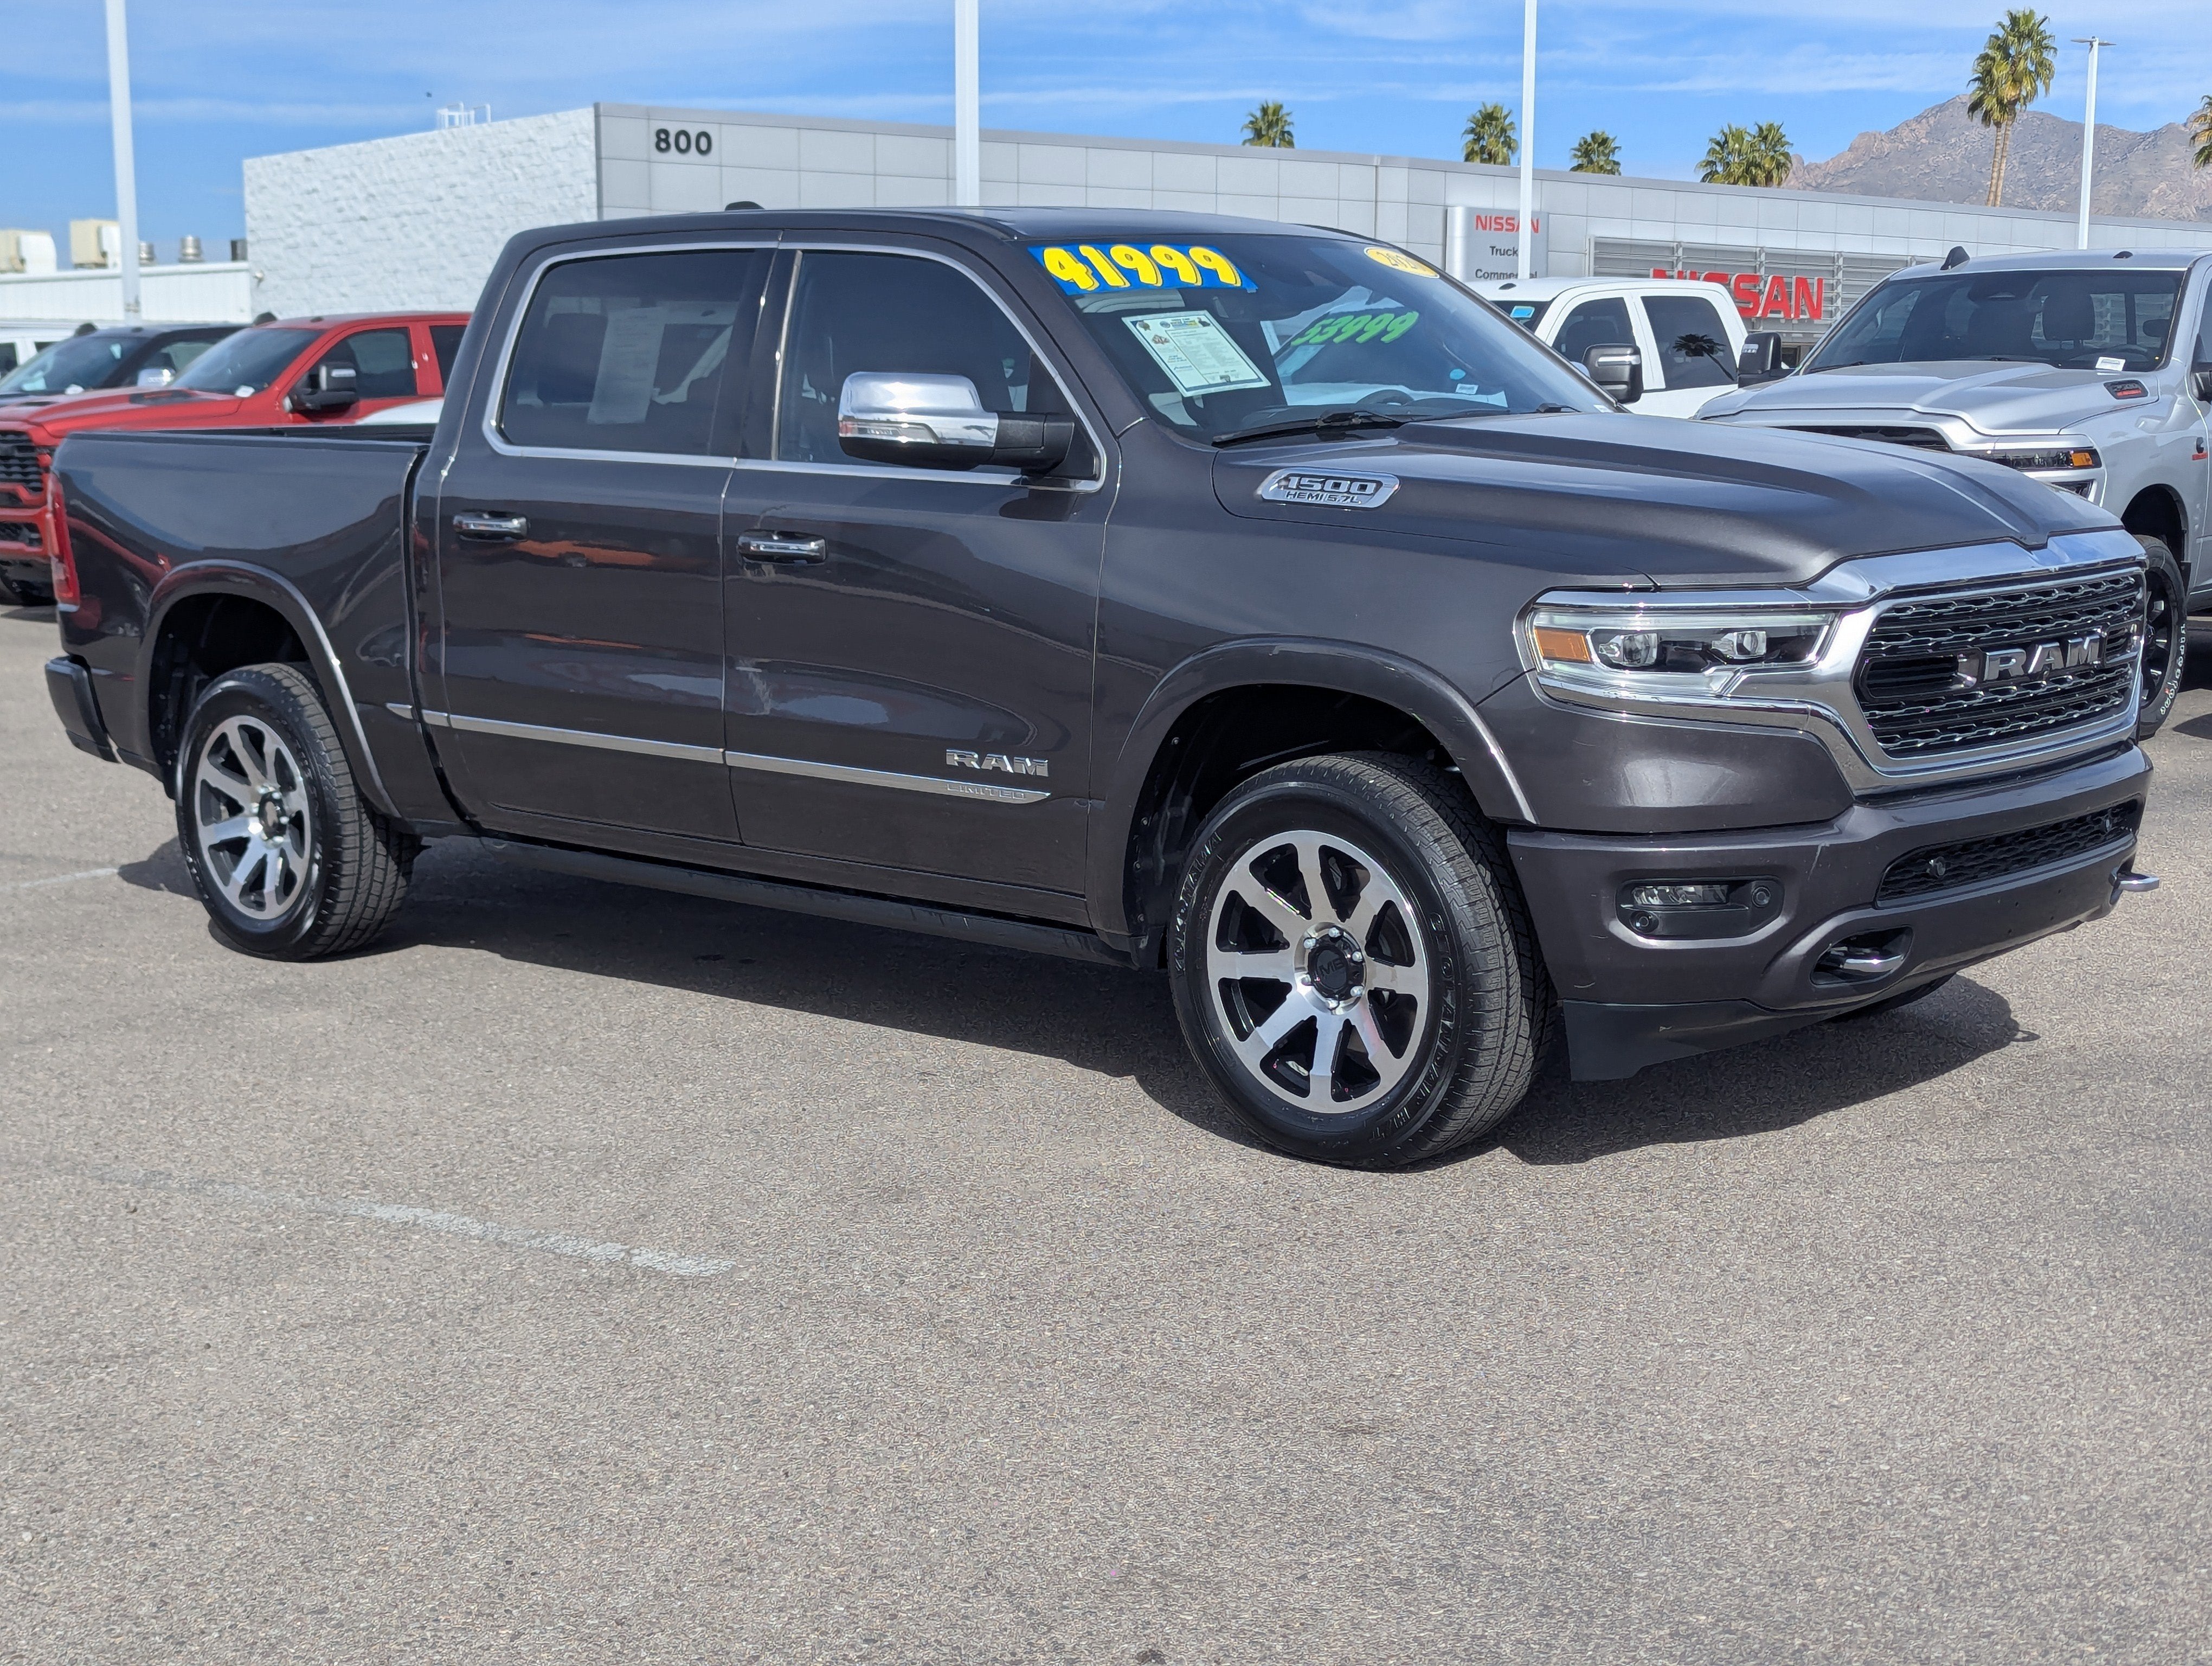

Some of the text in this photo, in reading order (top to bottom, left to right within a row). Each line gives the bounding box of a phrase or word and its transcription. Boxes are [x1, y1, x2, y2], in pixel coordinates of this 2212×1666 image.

[655, 128, 712, 156] 800
[1475, 214, 1540, 234] NISSN
[1044, 245, 1243, 291] 41999
[1650, 268, 1824, 320] SAN
[1285, 491, 1360, 504] HEMI 5.7L
[1286, 476, 1377, 495] 1500
[1983, 634, 2101, 682] RAM
[946, 749, 1049, 777] RAM
